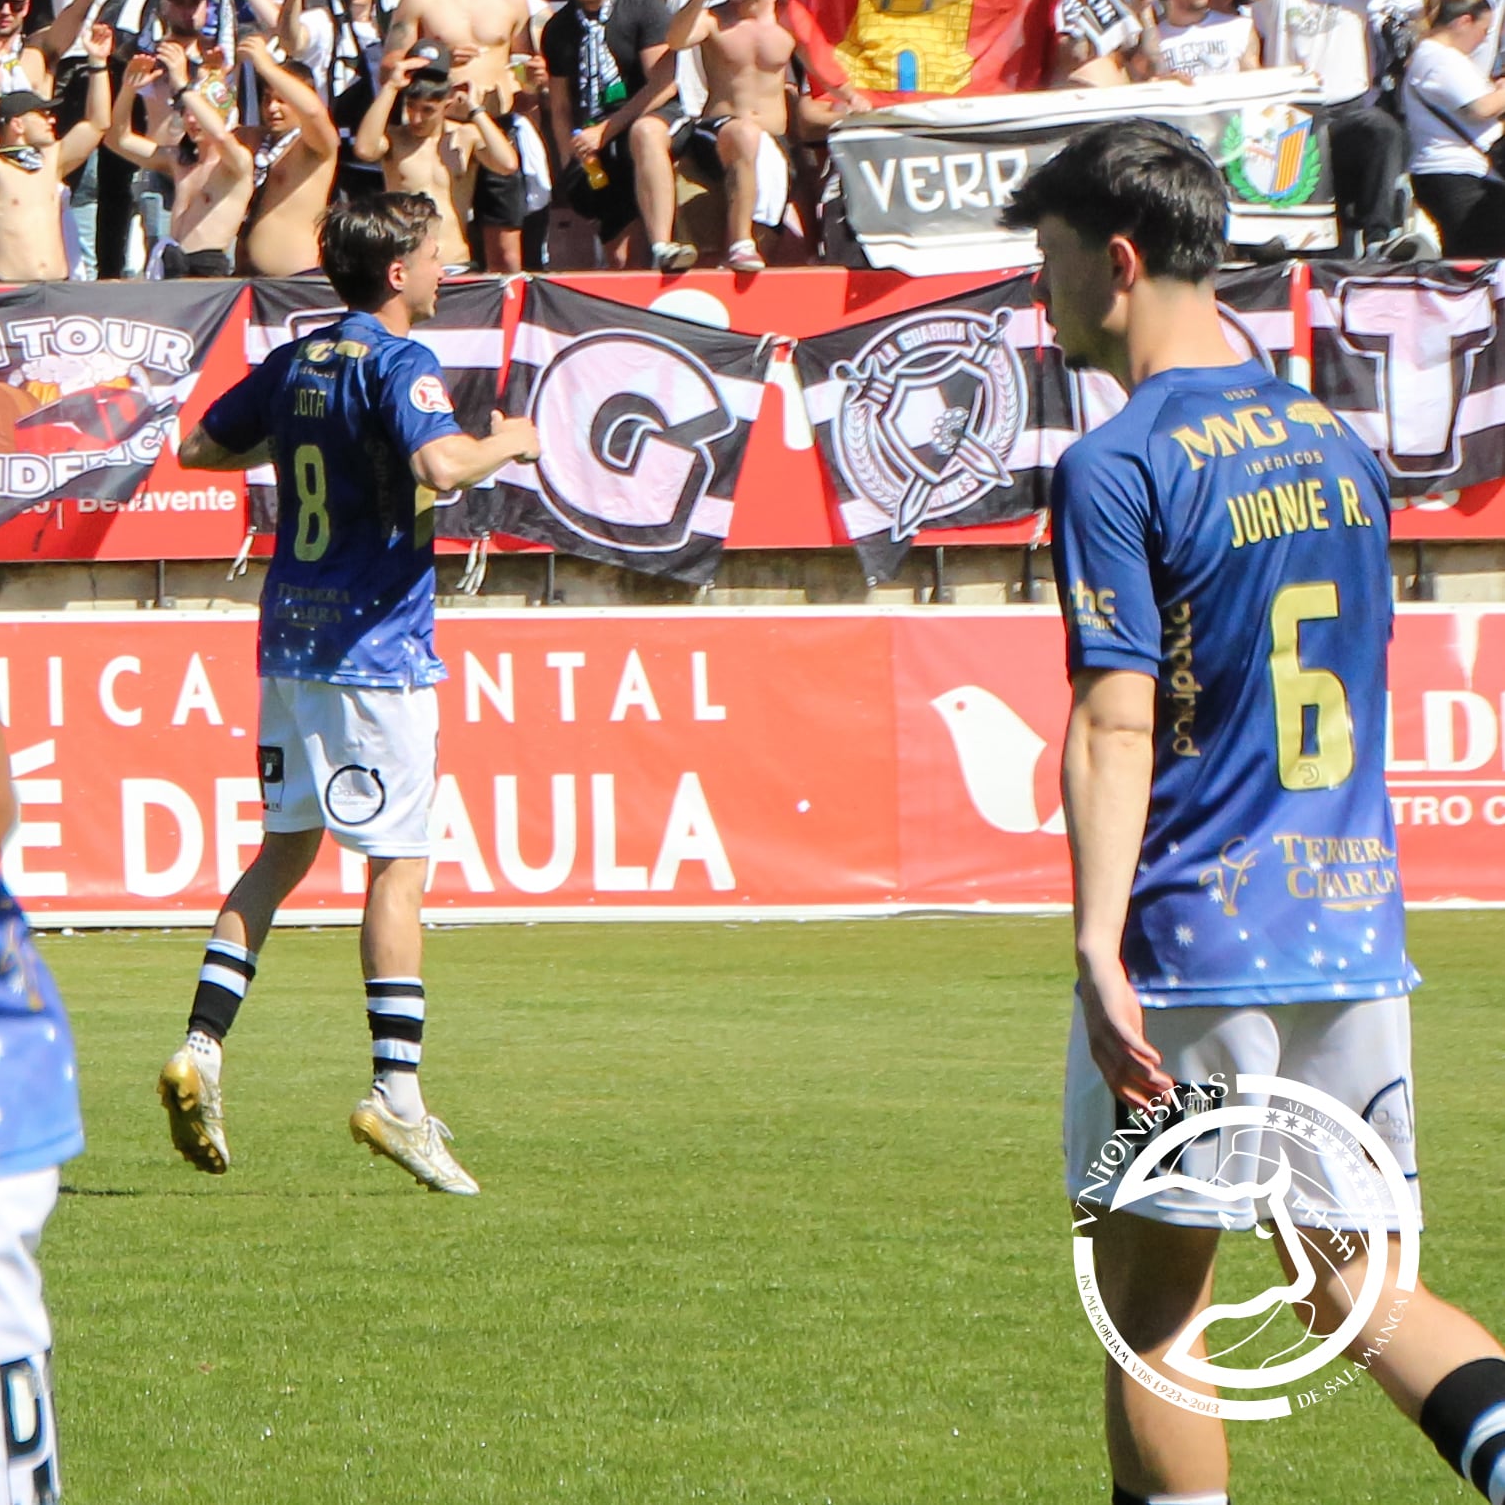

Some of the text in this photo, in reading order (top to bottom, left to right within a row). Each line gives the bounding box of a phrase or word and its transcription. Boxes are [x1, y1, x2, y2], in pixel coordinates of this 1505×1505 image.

[6, 315, 194, 376] TOUR
[896, 322, 967, 351] GUARDIA
[1171, 405, 1289, 471] MMG
[1246, 448, 1323, 477] IBÉRICOS
[293, 445, 332, 562] 8
[1338, 476, 1373, 527] R.
[1270, 581, 1354, 792] 6
